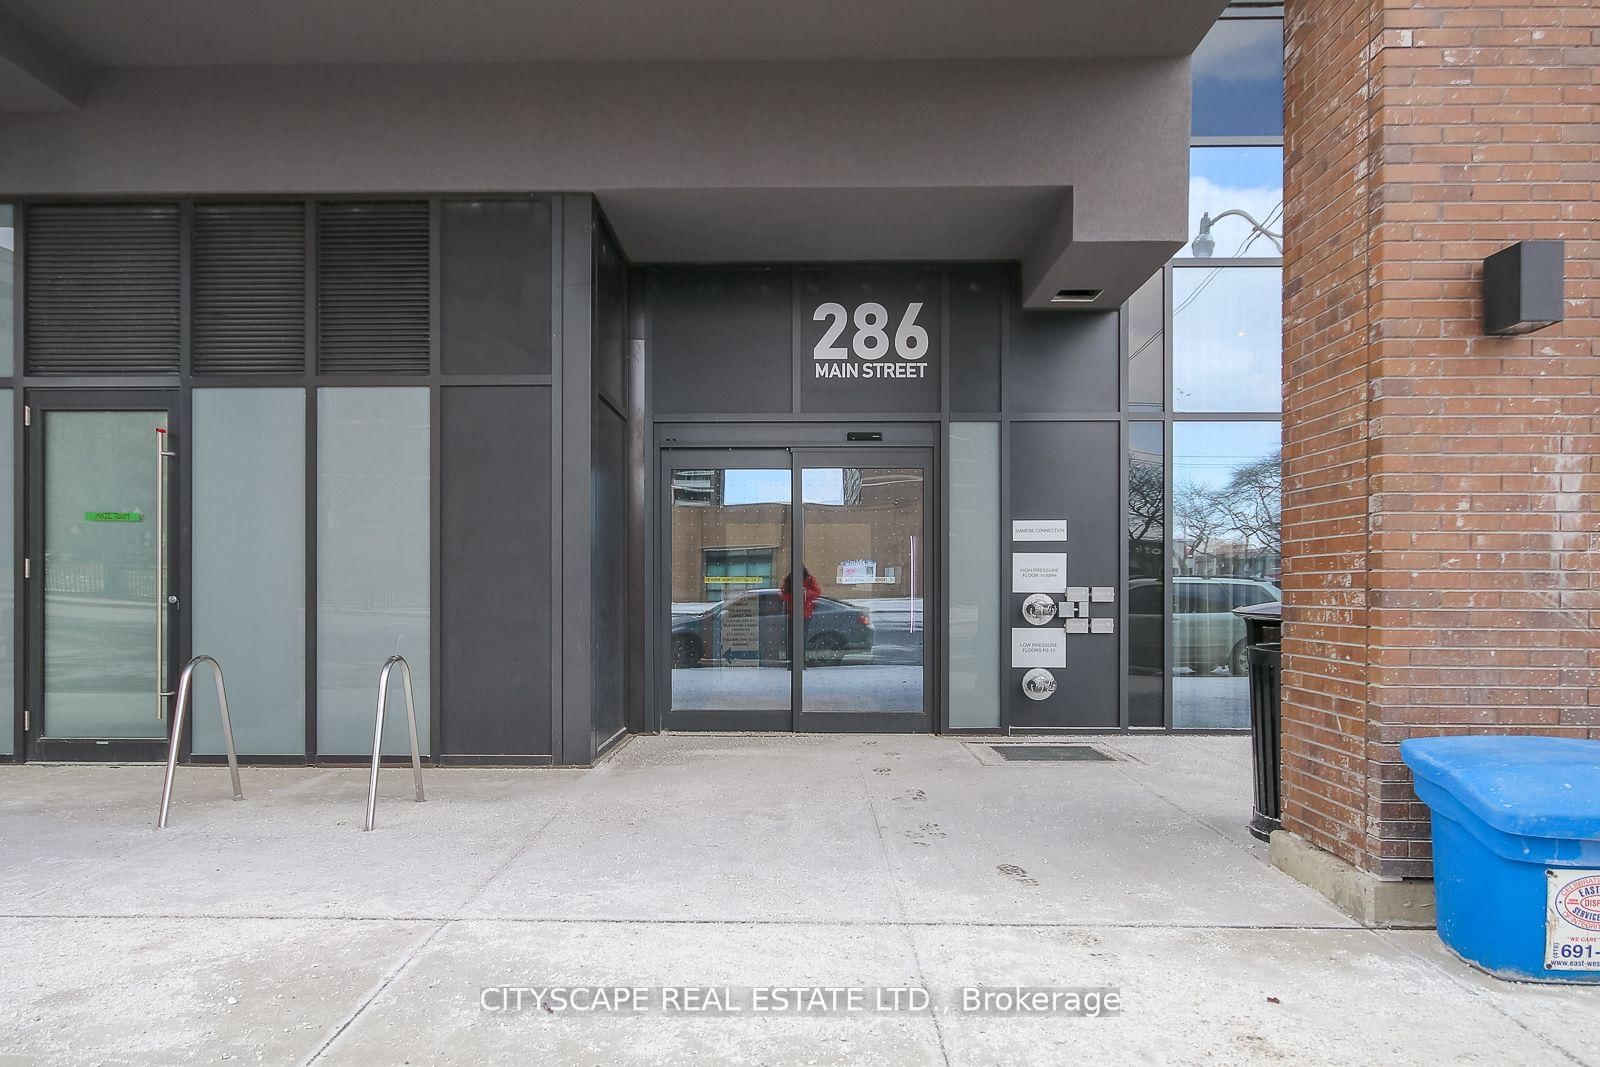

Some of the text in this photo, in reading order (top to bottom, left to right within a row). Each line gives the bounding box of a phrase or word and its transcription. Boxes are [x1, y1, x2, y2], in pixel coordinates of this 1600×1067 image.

[813, 302, 929, 360] 286
[815, 362, 928, 378] MAIN STREET
[1579, 885, 1600, 898] EAST
